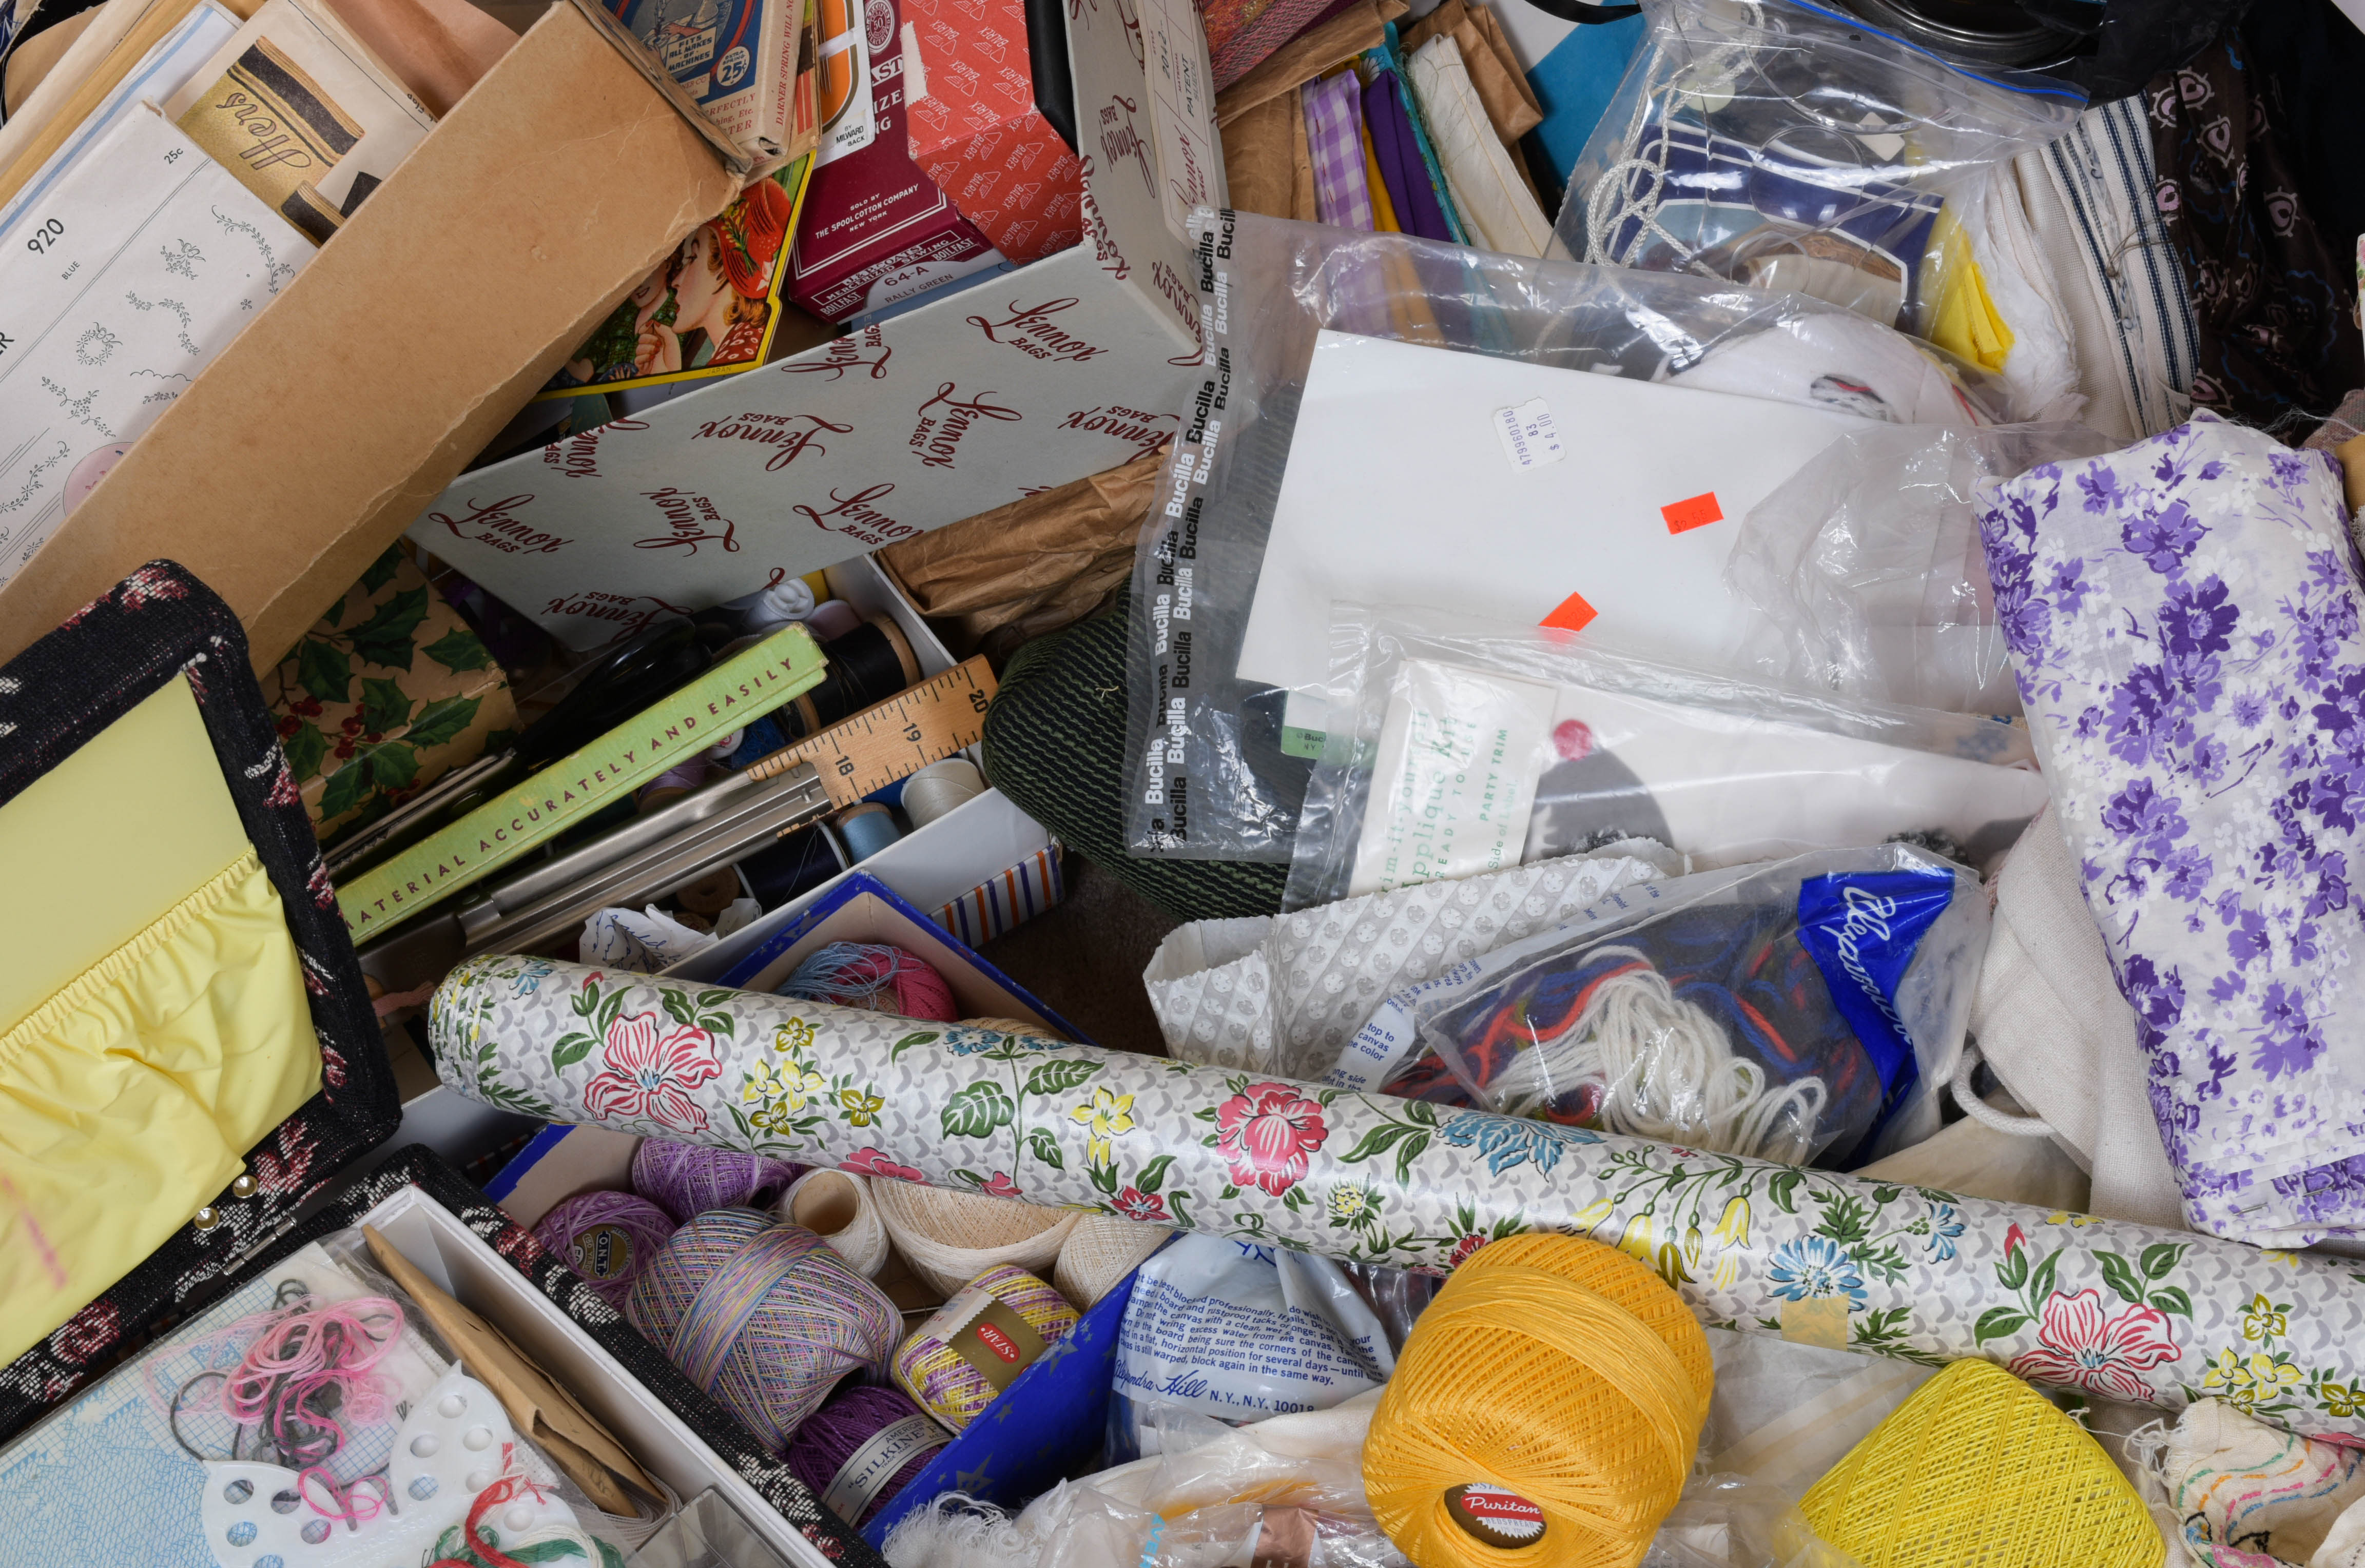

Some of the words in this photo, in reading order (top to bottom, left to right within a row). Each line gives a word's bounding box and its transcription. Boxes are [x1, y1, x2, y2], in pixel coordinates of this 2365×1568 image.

[784, 12, 793, 40] WILL
[874, 17, 883, 30] 50
[931, 19, 960, 40] BALREX
[978, 26, 1010, 47] BALREX
[669, 49, 684, 59] ALL
[684, 37, 712, 54] MAKES
[679, 34, 702, 48] FITS
[668, 52, 710, 72] MACHINES
[781, 42, 791, 81] SPRING
[948, 60, 981, 81] BALREX
[998, 66, 1030, 87] BALREX
[1181, 53, 1194, 117] PATENT
[739, 108, 753, 117] Etc.
[776, 82, 787, 127] DARNER
[968, 100, 1001, 123] BALREX
[1100, 105, 1118, 125] BAGS
[216, 92, 312, 170] Hers
[836, 126, 864, 144] MILWARD
[848, 135, 865, 147] BACK
[164, 147, 184, 165] 25c
[963, 133, 985, 162] BALREX
[1004, 144, 1026, 171] BALREX
[1046, 155, 1068, 181] BALREX
[961, 172, 983, 199] BALREX
[1002, 184, 1024, 210] BALREX
[815, 227, 829, 240] THE
[831, 217, 855, 232] SPOOL
[855, 203, 882, 221] COTTON
[883, 183, 919, 205] COMPANY
[850, 200, 868, 211] SOLD
[1043, 194, 1064, 219] BALREX
[849, 222, 865, 232] NEW
[868, 210, 888, 222] YORK
[1000, 221, 1021, 247] BALREX
[27, 218, 65, 255] 920
[1039, 231, 1061, 255] BALREX
[932, 238, 974, 262] BOILFAST
[1199, 231, 1214, 294] Bucilla
[61, 262, 81, 281] BLUE
[826, 265, 896, 301] MERCERIZED
[901, 239, 949, 265] SEWING
[884, 266, 929, 286] 64-A
[885, 287, 915, 304] RALLY
[919, 274, 954, 290] GREEN
[820, 291, 861, 315] BOILFAST
[1215, 271, 1228, 335] Bucilla
[966, 298, 1109, 362] Lennox
[1202, 304, 1216, 367] Bucilla
[1009, 337, 1056, 360] BAGS
[707, 366, 731, 375] JAPAN
[1214, 347, 1229, 410] Bucilla
[738, 411, 793, 426] BAGS
[1104, 405, 1162, 423] BAGS
[1186, 380, 1215, 444] Bucilla
[909, 419, 937, 447] BAGS
[918, 382, 1023, 469] Lennox
[1503, 410, 1533, 465] 479960180
[1526, 424, 1538, 437] 83
[1537, 414, 1557, 438] 4.00
[691, 414, 854, 472] Lennox
[1193, 419, 1221, 485] Bucilla
[1165, 453, 1195, 518] Bucilla
[633, 487, 740, 557] Lennox
[692, 496, 721, 522] BAGS
[429, 494, 575, 555] Lennox
[838, 526, 885, 546] BAGS
[1179, 497, 1204, 560] Bucilla
[475, 533, 520, 554] BAGS
[1173, 568, 1193, 620] Bucilla
[1153, 594, 1171, 656] Bucilla
[1172, 631, 1191, 689] Bucilla
[968, 689, 990, 714] 20
[903, 722, 923, 743] 19
[1167, 697, 1186, 765] Bucilla
[479, 750, 636, 852] ACCURATELY
[650, 716, 696, 751] AND
[707, 657, 793, 715] EASILY
[835, 755, 856, 776] 18
[1145, 738, 1164, 805] Bucilla
[1480, 773, 1499, 821] PARTY
[1491, 729, 1508, 765] TRIM
[1170, 777, 1187, 842] Bucilla
[1488, 840, 1504, 869] Side
[1358, 1031, 1389, 1052] canvas
[1368, 1023, 1383, 1037] top
[1385, 1031, 1395, 1042] to
[1360, 1044, 1385, 1062] color
[1347, 1073, 1367, 1084] side
[1159, 1291, 1185, 1311] board
[1186, 1304, 1205, 1314] and
[1207, 1308, 1251, 1324] rustproof
[1252, 1316, 1276, 1325] tacks
[1208, 1298, 1275, 1318] professionally.
[1303, 1311, 1323, 1321] wish
[1154, 1301, 1168, 1316] the
[1170, 1312, 1203, 1324] canvas
[1205, 1314, 1223, 1325] with
[1234, 1322, 1262, 1332] clean,
[1320, 1333, 1334, 1342] pat
[983, 1329, 1013, 1355] STAR
[1155, 1327, 1184, 1342] board
[1188, 1335, 1212, 1345] being
[1215, 1338, 1235, 1346] sure
[1239, 1340, 1255, 1348] the
[1259, 1342, 1296, 1355] corners
[1302, 1349, 1312, 1357] of
[1316, 1351, 1332, 1361] the
[1159, 1319, 1186, 1332] wring
[1190, 1326, 1218, 1334] excess
[1223, 1328, 1249, 1339] water
[1252, 1332, 1274, 1341] from
[1299, 1337, 1335, 1351] canvas.
[1141, 1345, 1152, 1355] still
[1154, 1349, 1188, 1364] warped,
[1191, 1356, 1216, 1366] block
[1219, 1360, 1245, 1371] again
[1249, 1362, 1258, 1373] in
[1261, 1365, 1277, 1375] the
[1281, 1370, 1309, 1380] same
[1312, 1374, 1334, 1385] way.
[1161, 1339, 1207, 1354] horizontal
[1208, 1348, 1246, 1359] position
[1249, 1351, 1263, 1362] for
[1266, 1355, 1302, 1367] several
[1305, 1361, 1328, 1372] days
[1342, 1367, 1364, 1378] until
[1155, 1369, 1208, 1398] Hill
[886, 1418, 925, 1443] AMERICAN
[1465, 1496, 1540, 1514] Puritan
[1486, 1517, 1535, 1528] BEDSPREAD
